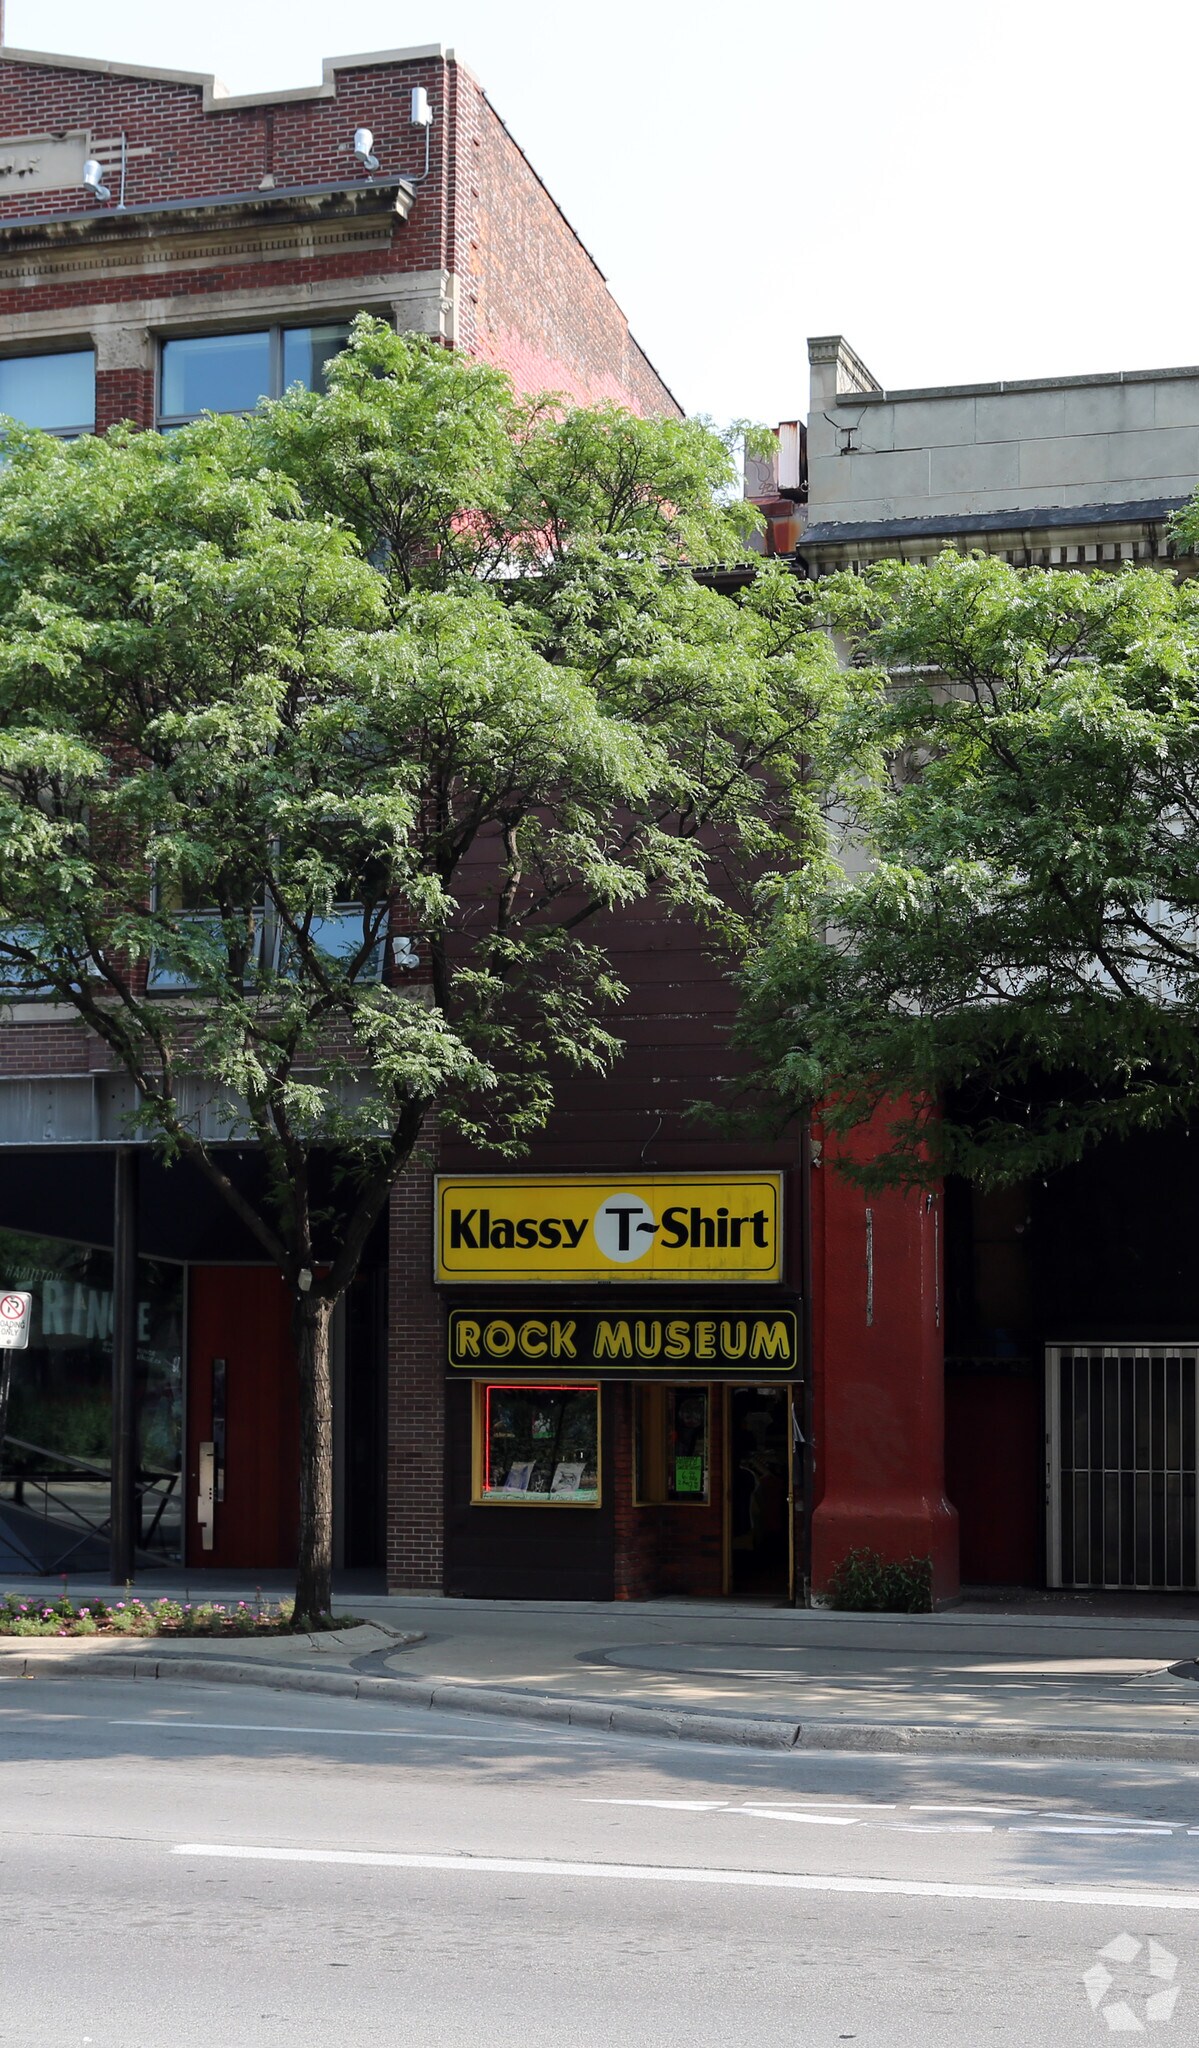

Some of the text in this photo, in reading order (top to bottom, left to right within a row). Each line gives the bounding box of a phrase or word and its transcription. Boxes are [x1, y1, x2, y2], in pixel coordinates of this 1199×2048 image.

[451, 1209, 589, 1249] Klassy
[5, 1265, 63, 1282] HAMILTON
[1, 1328, 19, 1336] ONLY
[456, 1320, 791, 1360] ROCK MUSEUM
